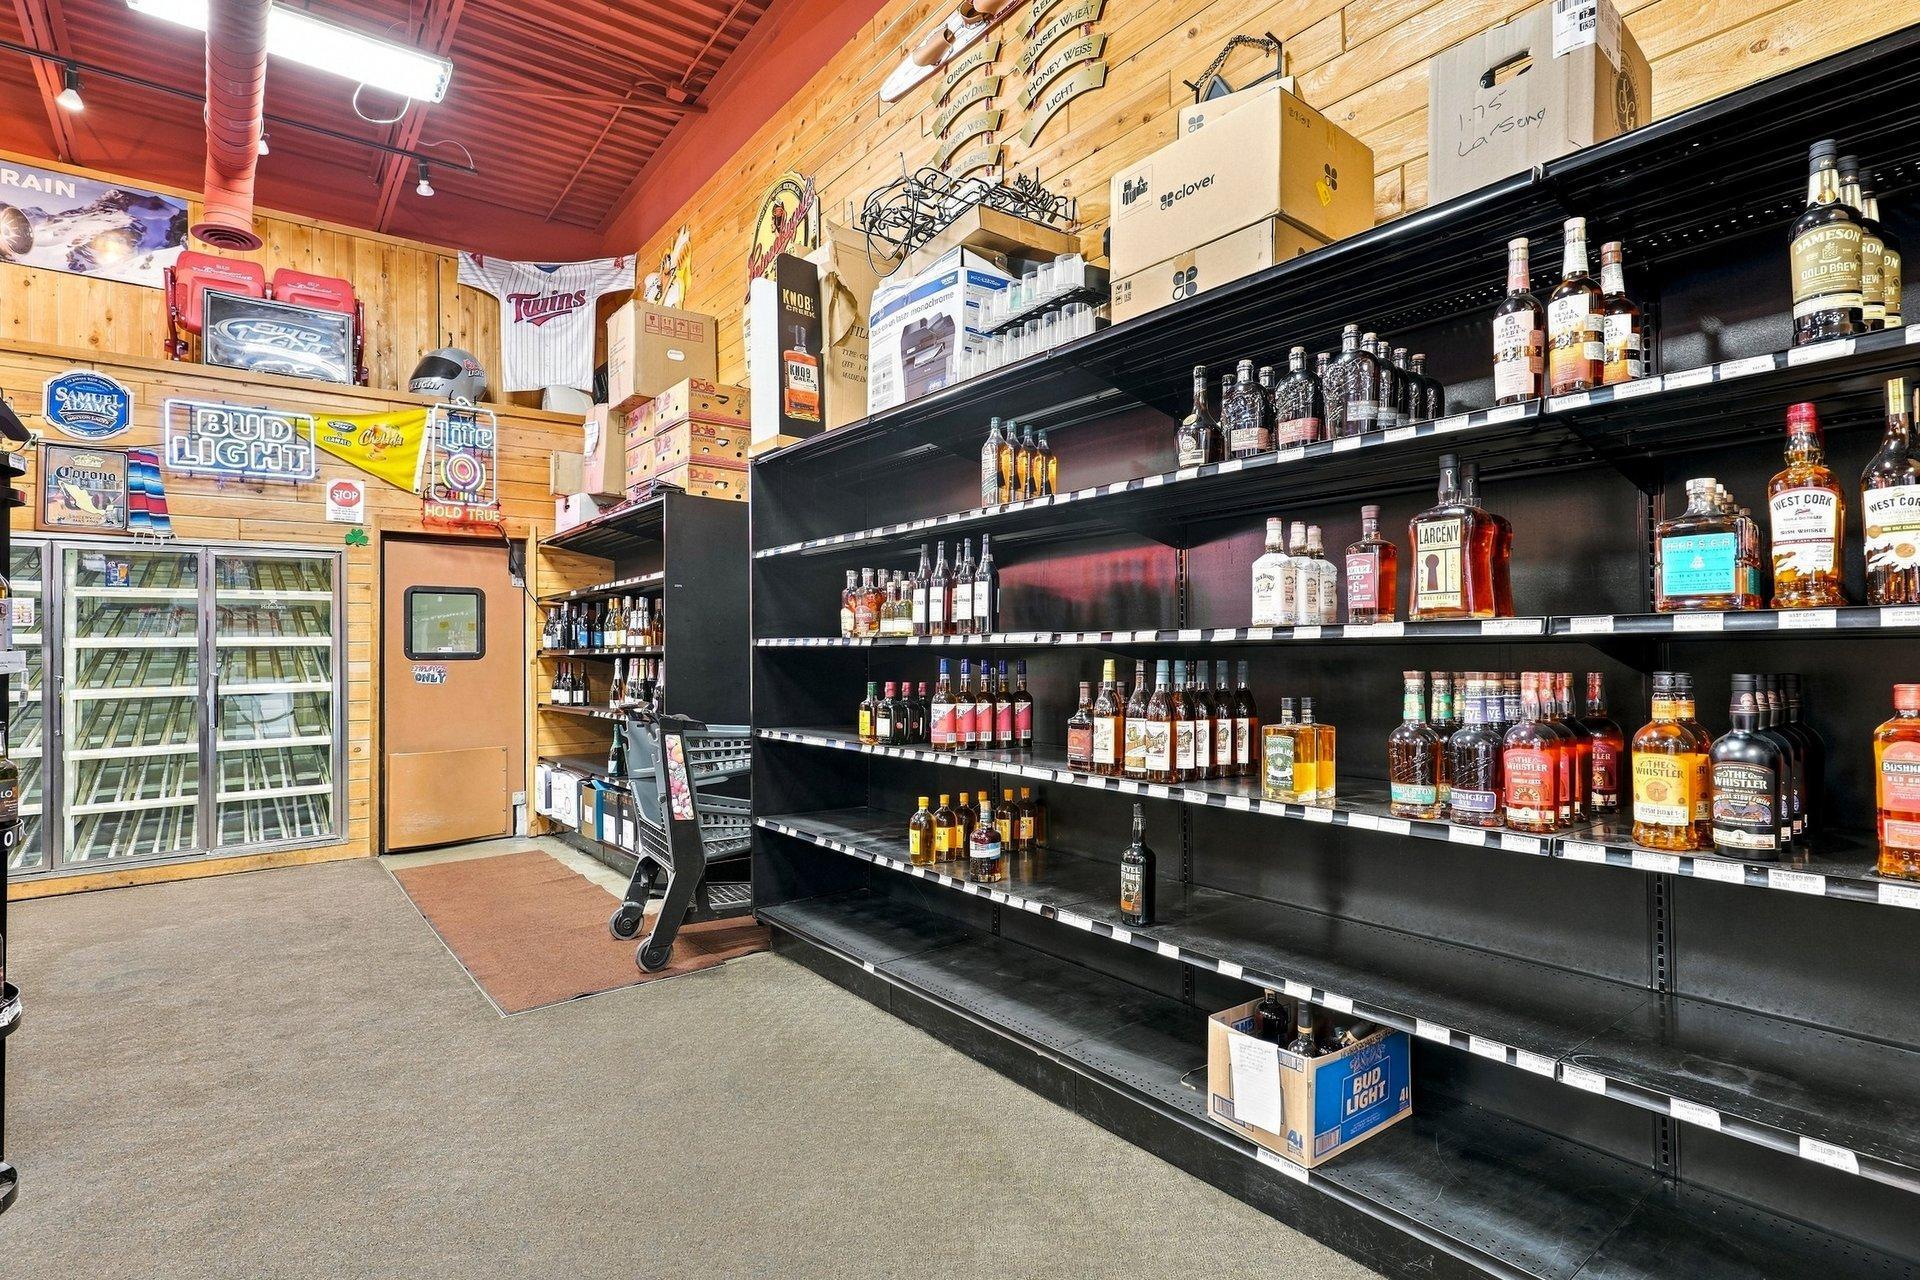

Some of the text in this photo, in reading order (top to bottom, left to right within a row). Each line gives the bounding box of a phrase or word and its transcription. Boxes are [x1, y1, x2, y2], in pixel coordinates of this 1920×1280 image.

[1023, 5, 1095, 65] SUNSET WHEAT
[947, 51, 983, 84] ORIGINAL
[1027, 43, 1093, 97] HONEY WEISS
[1046, 82, 1075, 112] LIGHT
[1, 168, 76, 199] RAIN
[1175, 173, 1215, 201] clover
[1795, 228, 1860, 255] JAMESON
[1829, 261, 1857, 272] BREW
[506, 289, 587, 324] Twins
[782, 288, 811, 311] KNOB
[910, 291, 955, 317] monochrome
[785, 304, 816, 318] CREEK
[253, 321, 322, 342] BUD
[790, 364, 811, 379] KNOB
[691, 379, 715, 393] Dole
[55, 386, 120, 405] SAMUEL
[60, 401, 123, 418] ADAMS
[197, 408, 293, 444] BUD
[691, 422, 716, 436] Dole
[436, 419, 493, 453] Lite
[172, 435, 310, 472] LIGHT
[55, 465, 116, 482] Corona
[690, 468, 714, 481] Dole
[332, 490, 359, 500] STOP
[1774, 494, 1833, 511] WEST CORK
[425, 505, 501, 522] HOLD TRUE
[1869, 499, 1896, 513] WEST
[1419, 524, 1459, 545] LARCENY
[415, 671, 446, 683] ONLY
[1505, 761, 1548, 772] WHISTLER
[1635, 767, 1684, 779] WHISTLER
[1648, 760, 1666, 768] THE
[1714, 776, 1767, 790] WHISTLER
[1727, 770, 1748, 780] THE
[1353, 1066, 1381, 1095] BUD
[1346, 1080, 1386, 1116] LIGHT
